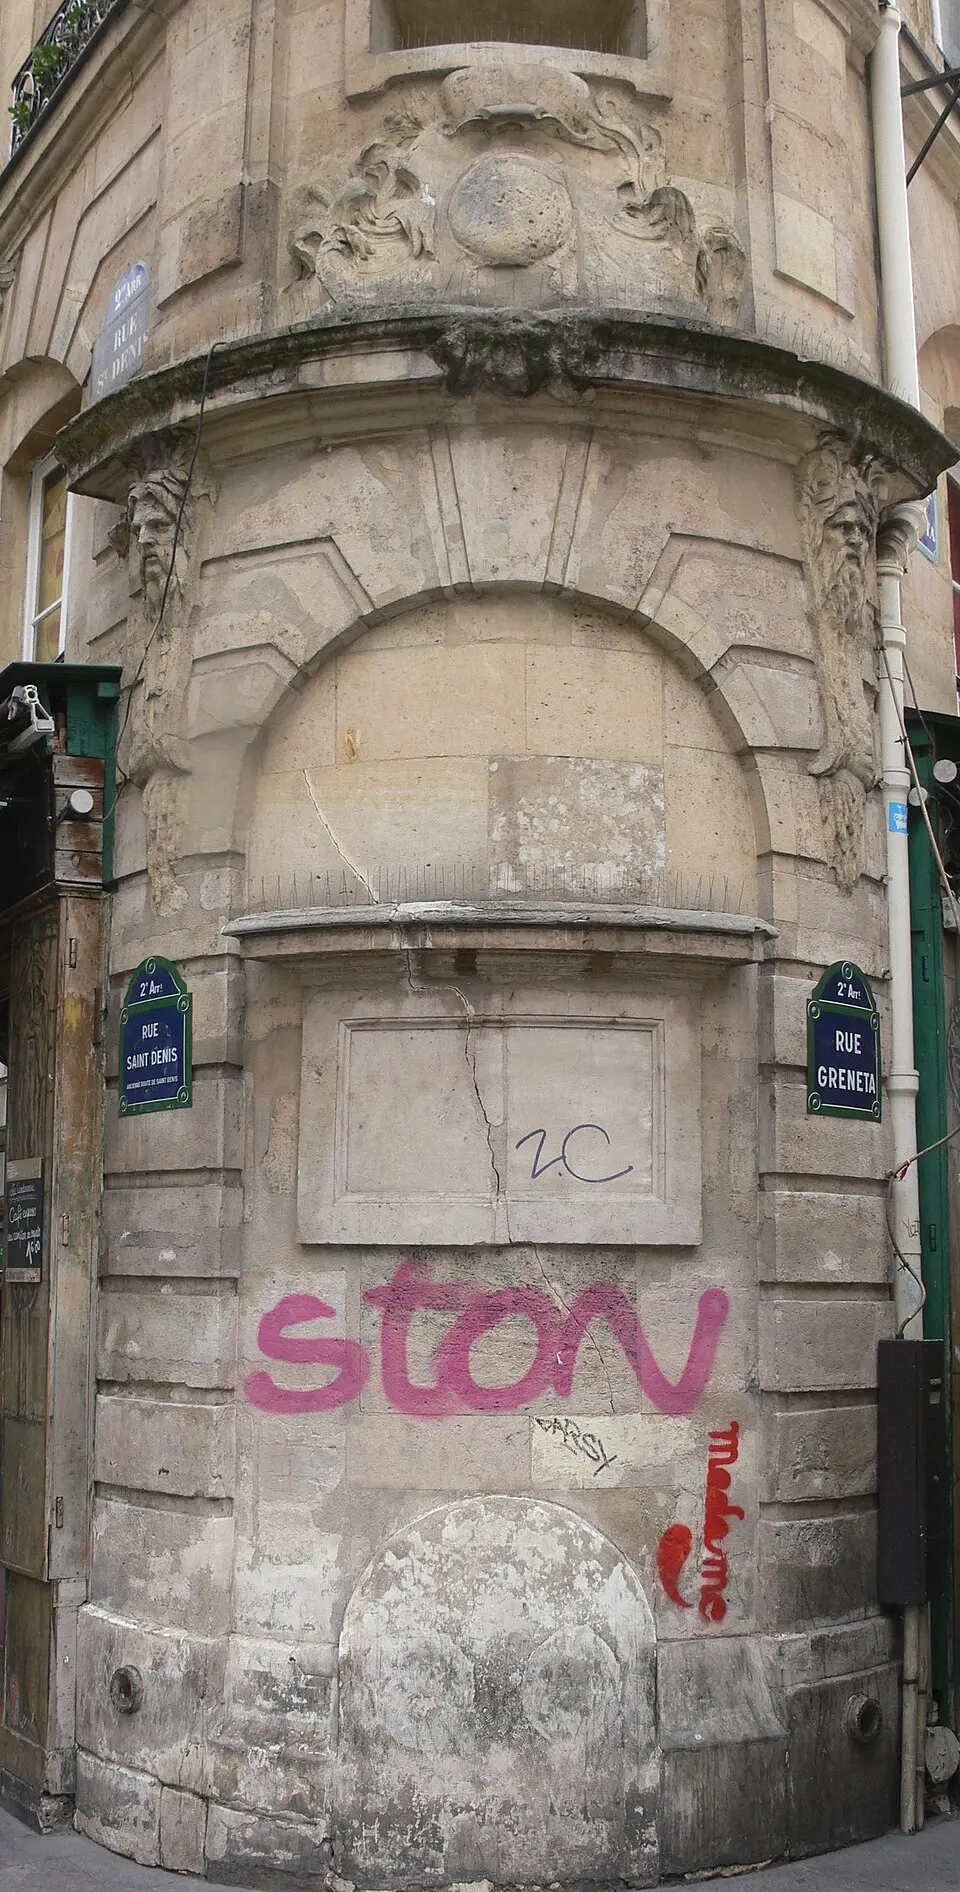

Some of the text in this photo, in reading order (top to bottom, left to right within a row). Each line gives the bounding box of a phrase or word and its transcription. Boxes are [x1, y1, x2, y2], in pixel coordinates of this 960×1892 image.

[113, 313, 138, 351] RUE
[142, 1022, 159, 1039] RUE
[836, 1030, 862, 1055] RUE
[126, 1047, 178, 1070] SAINT DENIS
[817, 1065, 876, 1095] GRENETA
